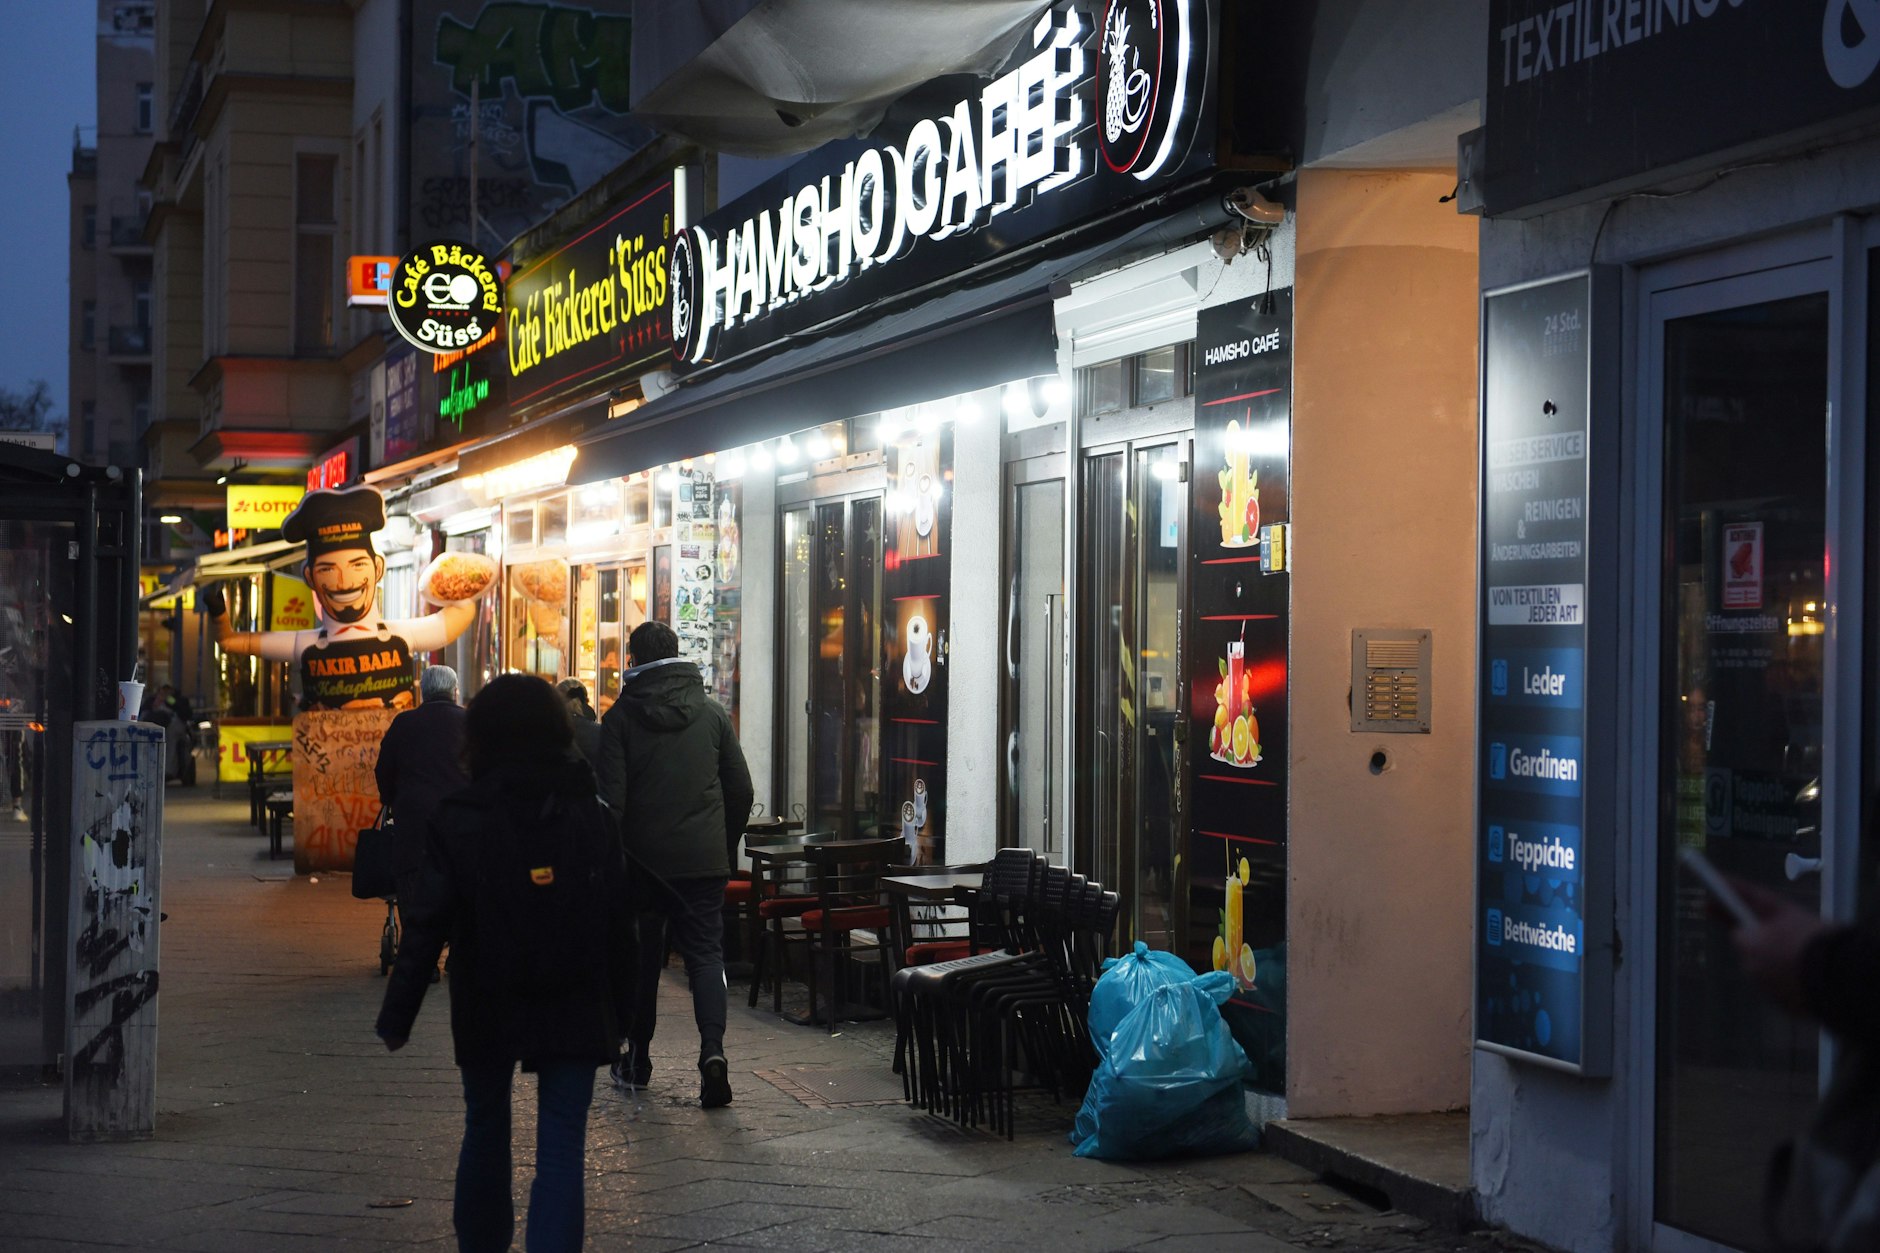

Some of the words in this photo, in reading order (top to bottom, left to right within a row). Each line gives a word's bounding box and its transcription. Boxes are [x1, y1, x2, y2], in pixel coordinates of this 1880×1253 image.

[708, 148, 886, 330] HAMSHO
[904, 5, 1085, 237] CAFÉ
[396, 254, 430, 308] Café
[430, 245, 502, 313] Bäckerei
[508, 290, 541, 377] Café
[543, 248, 618, 359] Bäckerei
[618, 234, 667, 323] Süss
[417, 318, 482, 347] Süss
[1544, 315, 1558, 336] 24
[1560, 309, 1581, 333] Std.
[1205, 339, 1250, 366] HAMSHO
[1252, 328, 1280, 354] CAFÉ
[1530, 435, 1580, 460] SERVICE
[1492, 469, 1540, 491] WASCHEN
[254, 502, 300, 513] LOTTO
[1525, 497, 1581, 521] REINIGEN
[1517, 519, 1526, 539] &
[1491, 541, 1581, 561] ÄNDERUNGSARBEITEN
[1492, 589, 1513, 606] VON
[1513, 587, 1561, 605] TEXTILIEN
[276, 616, 309, 628] LOTTO
[1528, 605, 1557, 623] JEDER
[1559, 604, 1579, 622] ART
[358, 649, 402, 673] BABA
[317, 675, 398, 698] Kebaphaus
[1523, 666, 1566, 696] Leder
[1510, 748, 1578, 781] Gardinen
[1508, 833, 1575, 871] Teppiche
[1504, 916, 1576, 954] Bettwäsche
